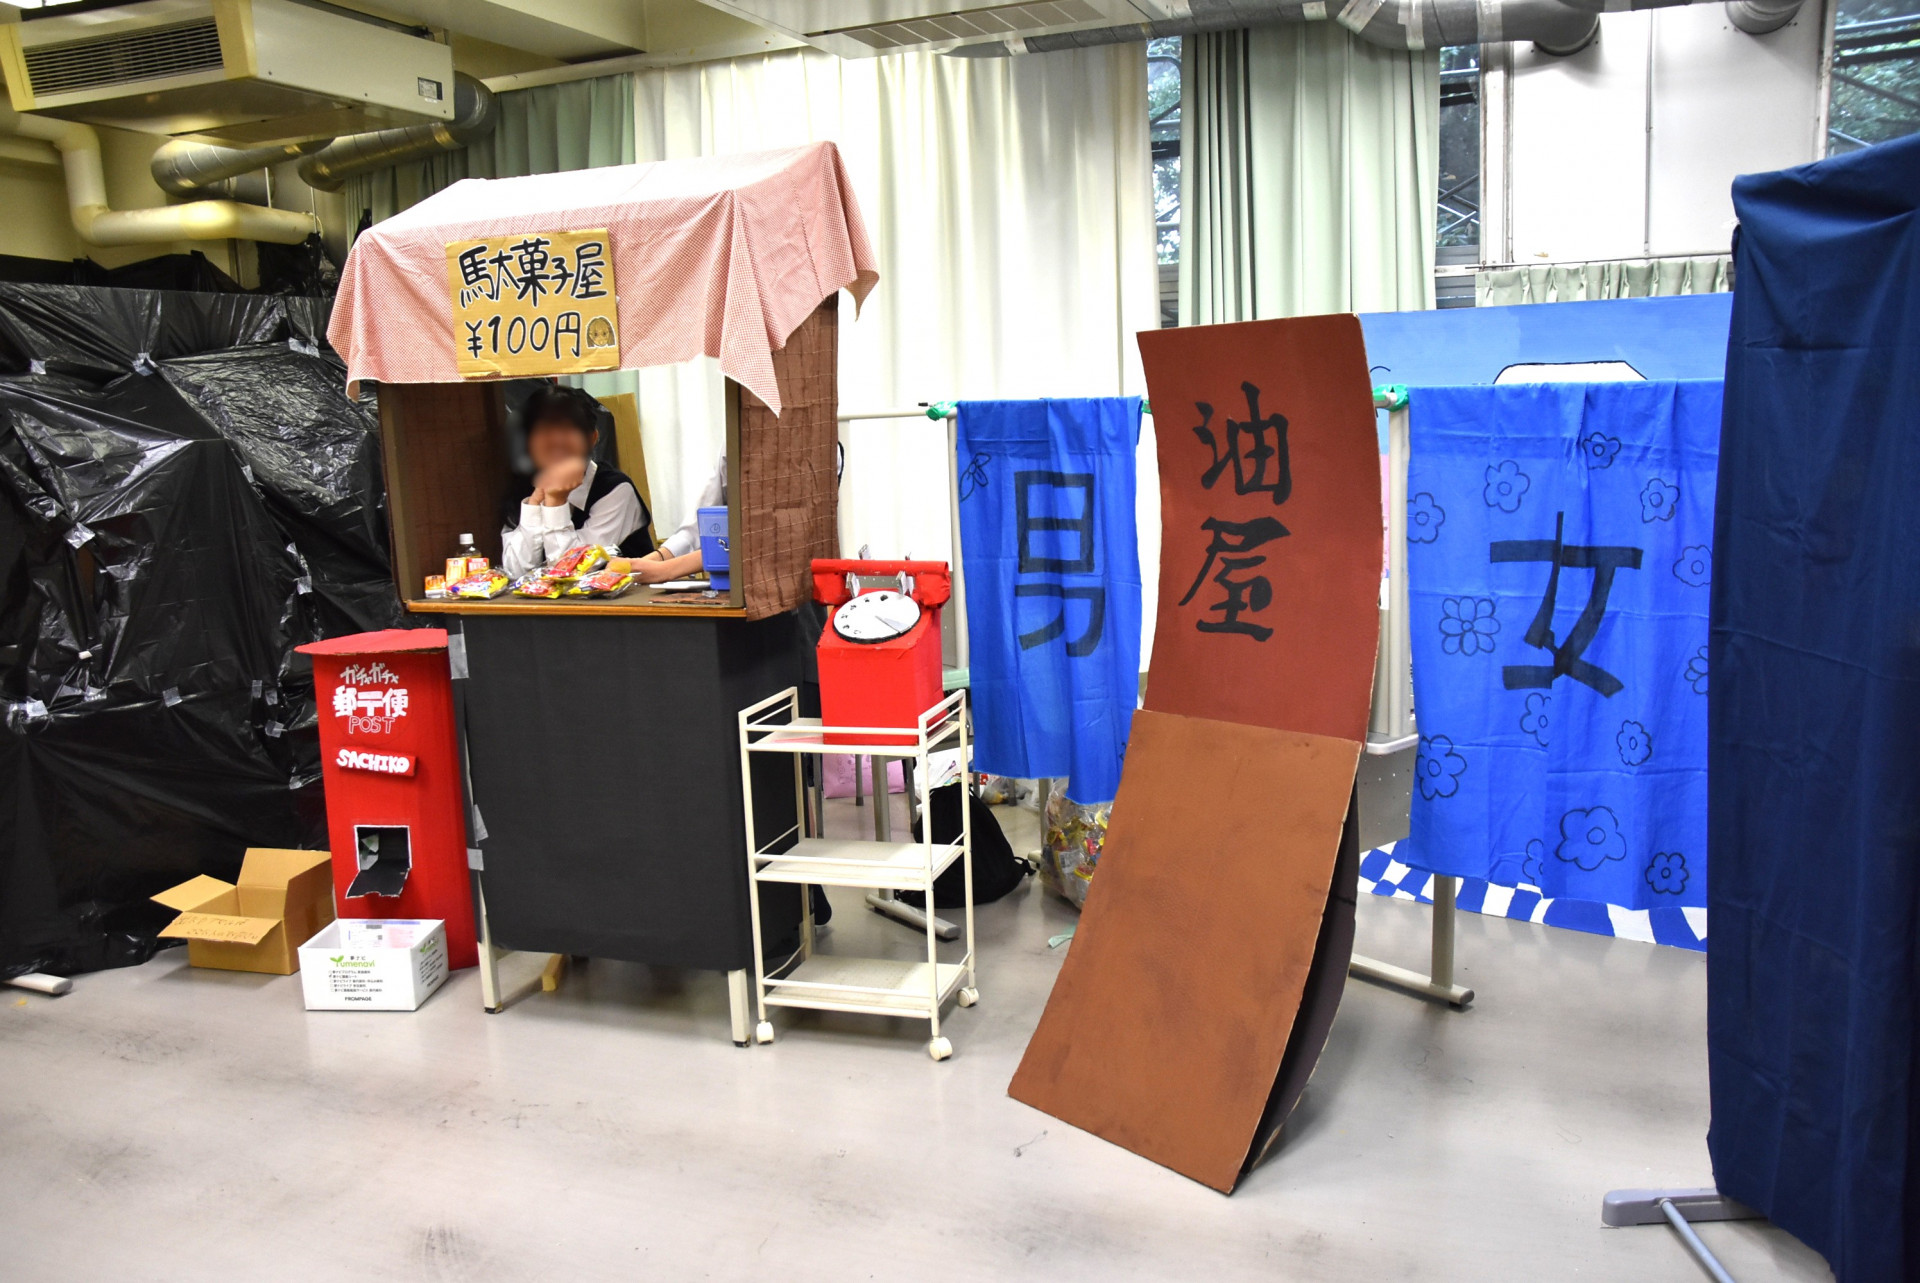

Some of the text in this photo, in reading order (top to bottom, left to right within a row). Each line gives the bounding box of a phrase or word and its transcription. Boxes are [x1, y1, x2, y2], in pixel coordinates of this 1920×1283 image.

[459, 238, 607, 308] 駄菓子屋
[465, 312, 580, 359] ¥100円
[1179, 380, 1292, 643] 油屋
[1014, 470, 1106, 657] 男
[1490, 511, 1642, 699] 女
[340, 662, 400, 685] ガチャガチャ
[348, 716, 396, 734] POST
[336, 748, 410, 773] SACHIKO
